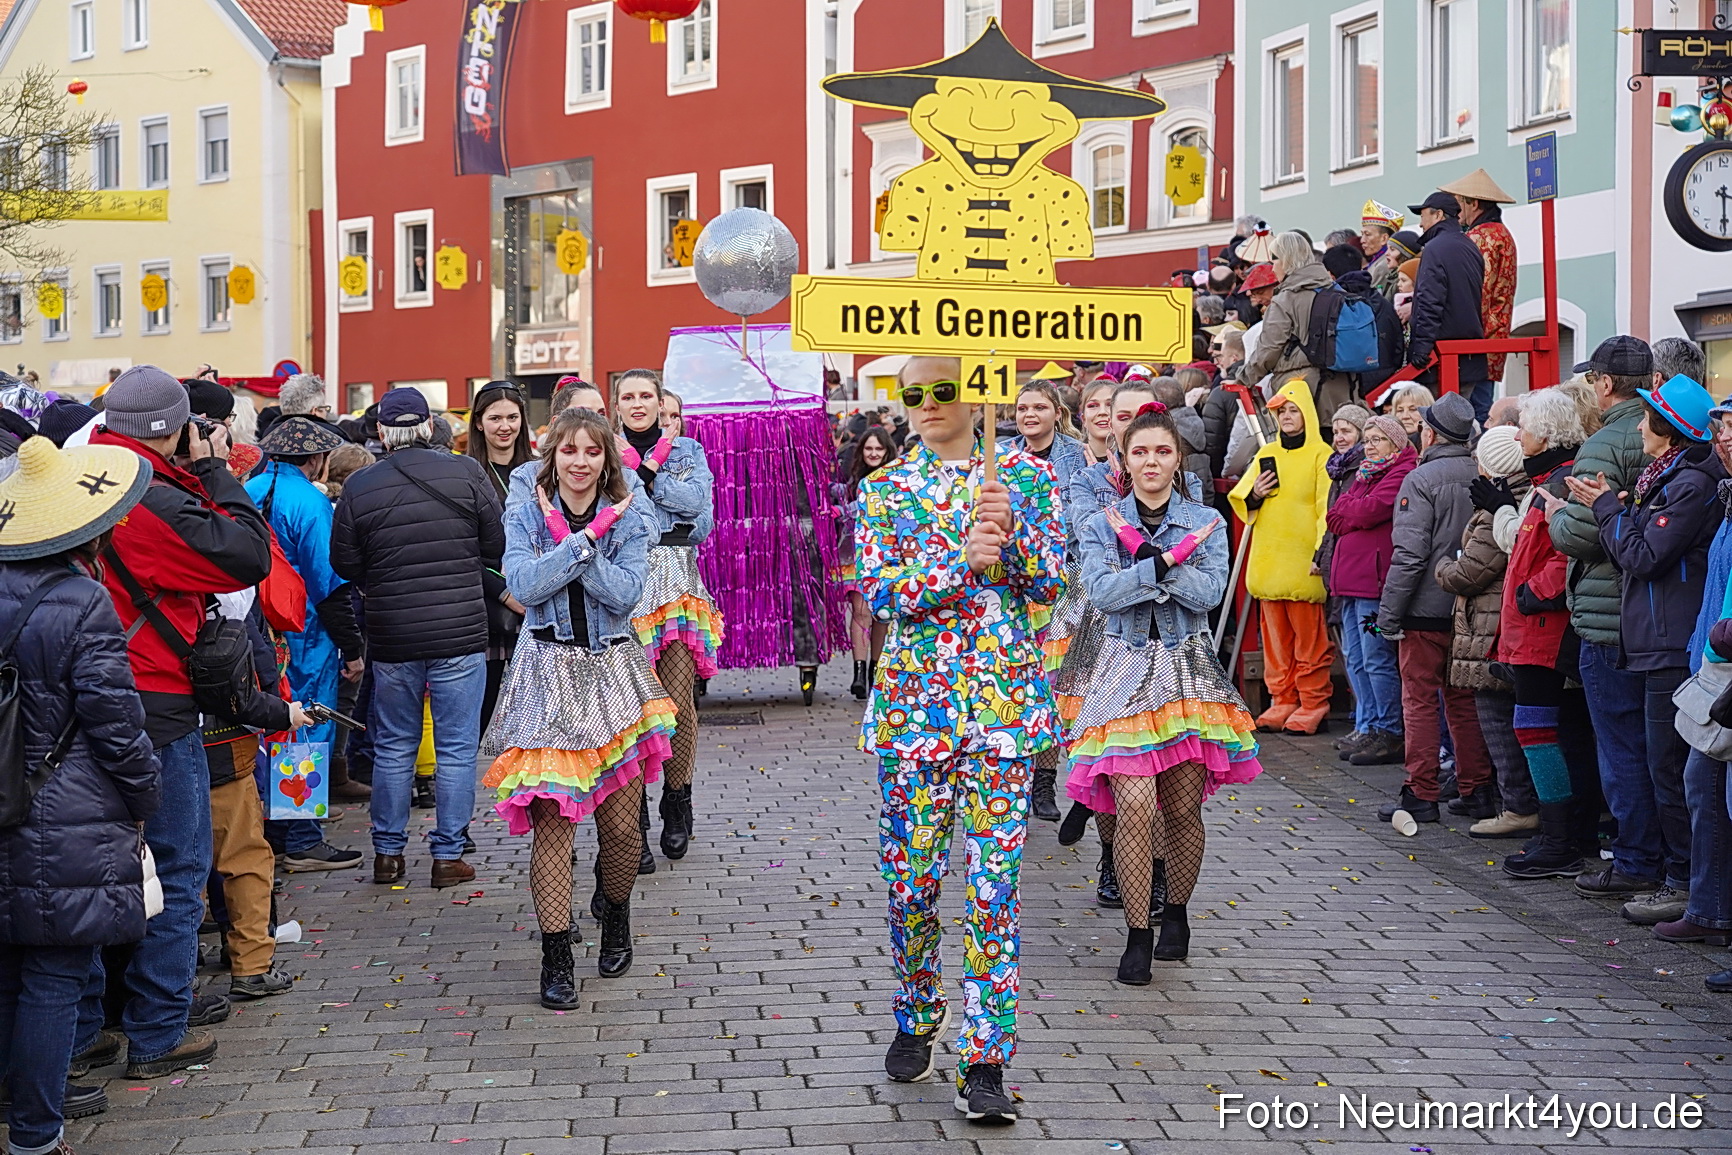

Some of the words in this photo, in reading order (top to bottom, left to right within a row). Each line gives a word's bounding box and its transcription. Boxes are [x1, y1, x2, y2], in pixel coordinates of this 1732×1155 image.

[1660, 36, 1732, 57] RÖH
[1705, 160, 1713, 173] 11
[1692, 172, 1702, 185] 10
[1688, 188, 1696, 201] 9
[1692, 205, 1701, 218] 8
[841, 299, 921, 335] next
[935, 298, 1143, 342] Generation
[966, 364, 1008, 397] 41
